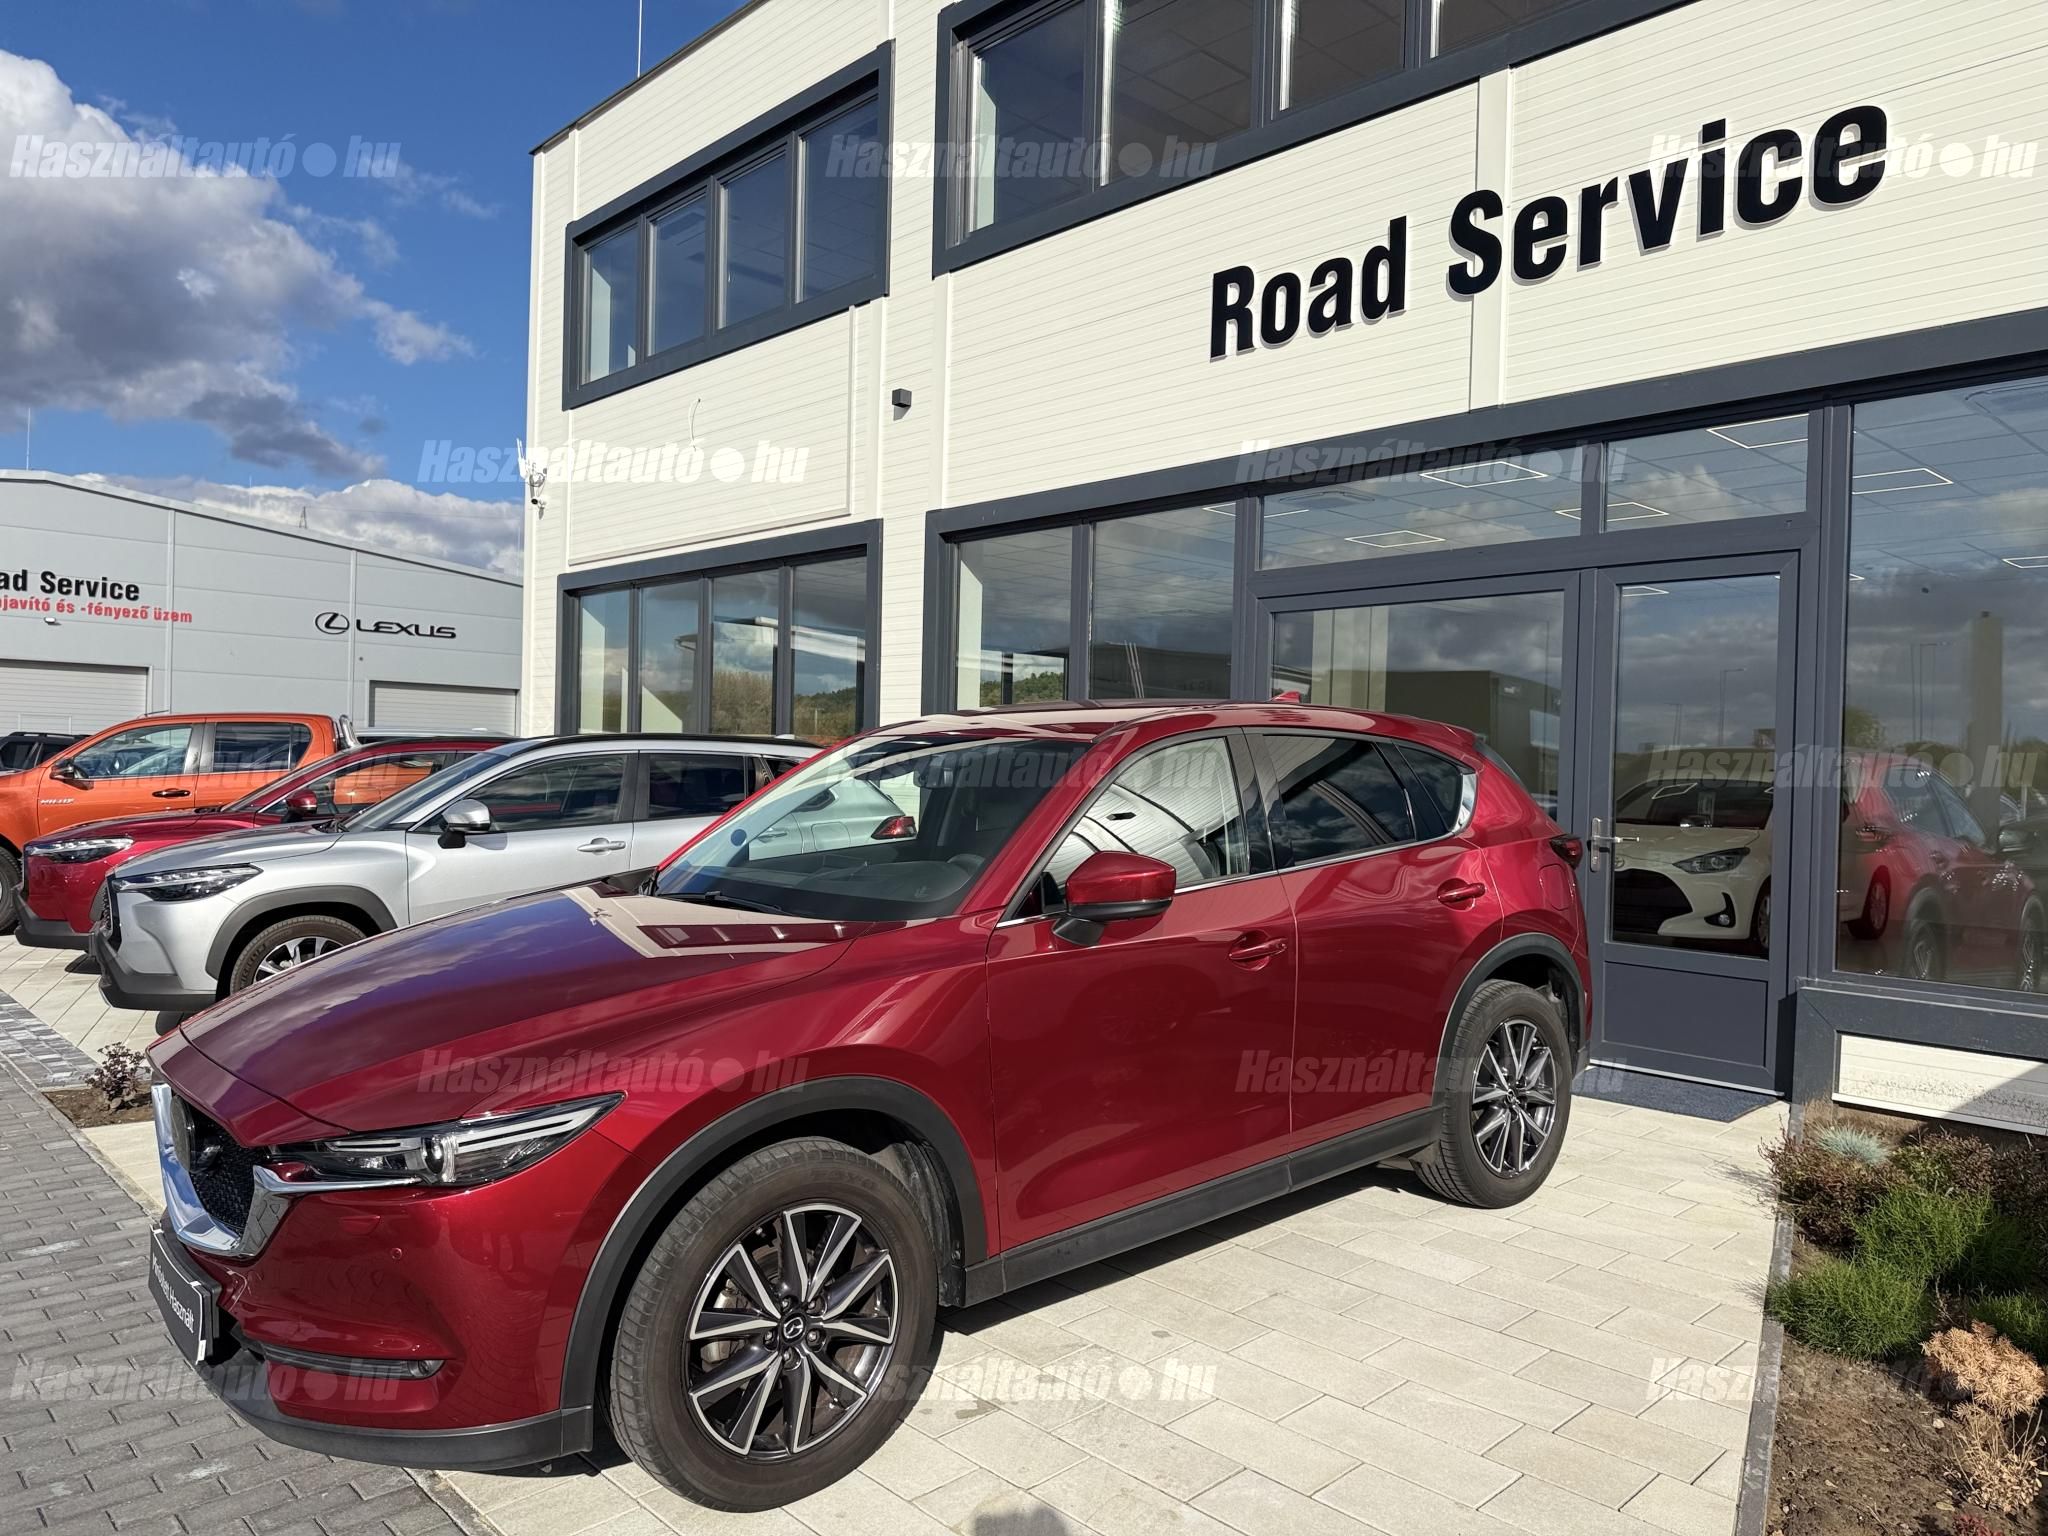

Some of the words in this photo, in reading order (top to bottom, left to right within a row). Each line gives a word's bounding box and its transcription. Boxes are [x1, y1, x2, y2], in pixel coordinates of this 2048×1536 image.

[1211, 216, 1406, 361] Road
[1446, 105, 1887, 297] Service
[40, 571, 139, 601] Service
[0, 595, 50, 611] javító
[56, 600, 75, 613] és
[80, 602, 150, 619] -fényező
[154, 607, 192, 623] üzem
[356, 619, 456, 639] LEXUS
